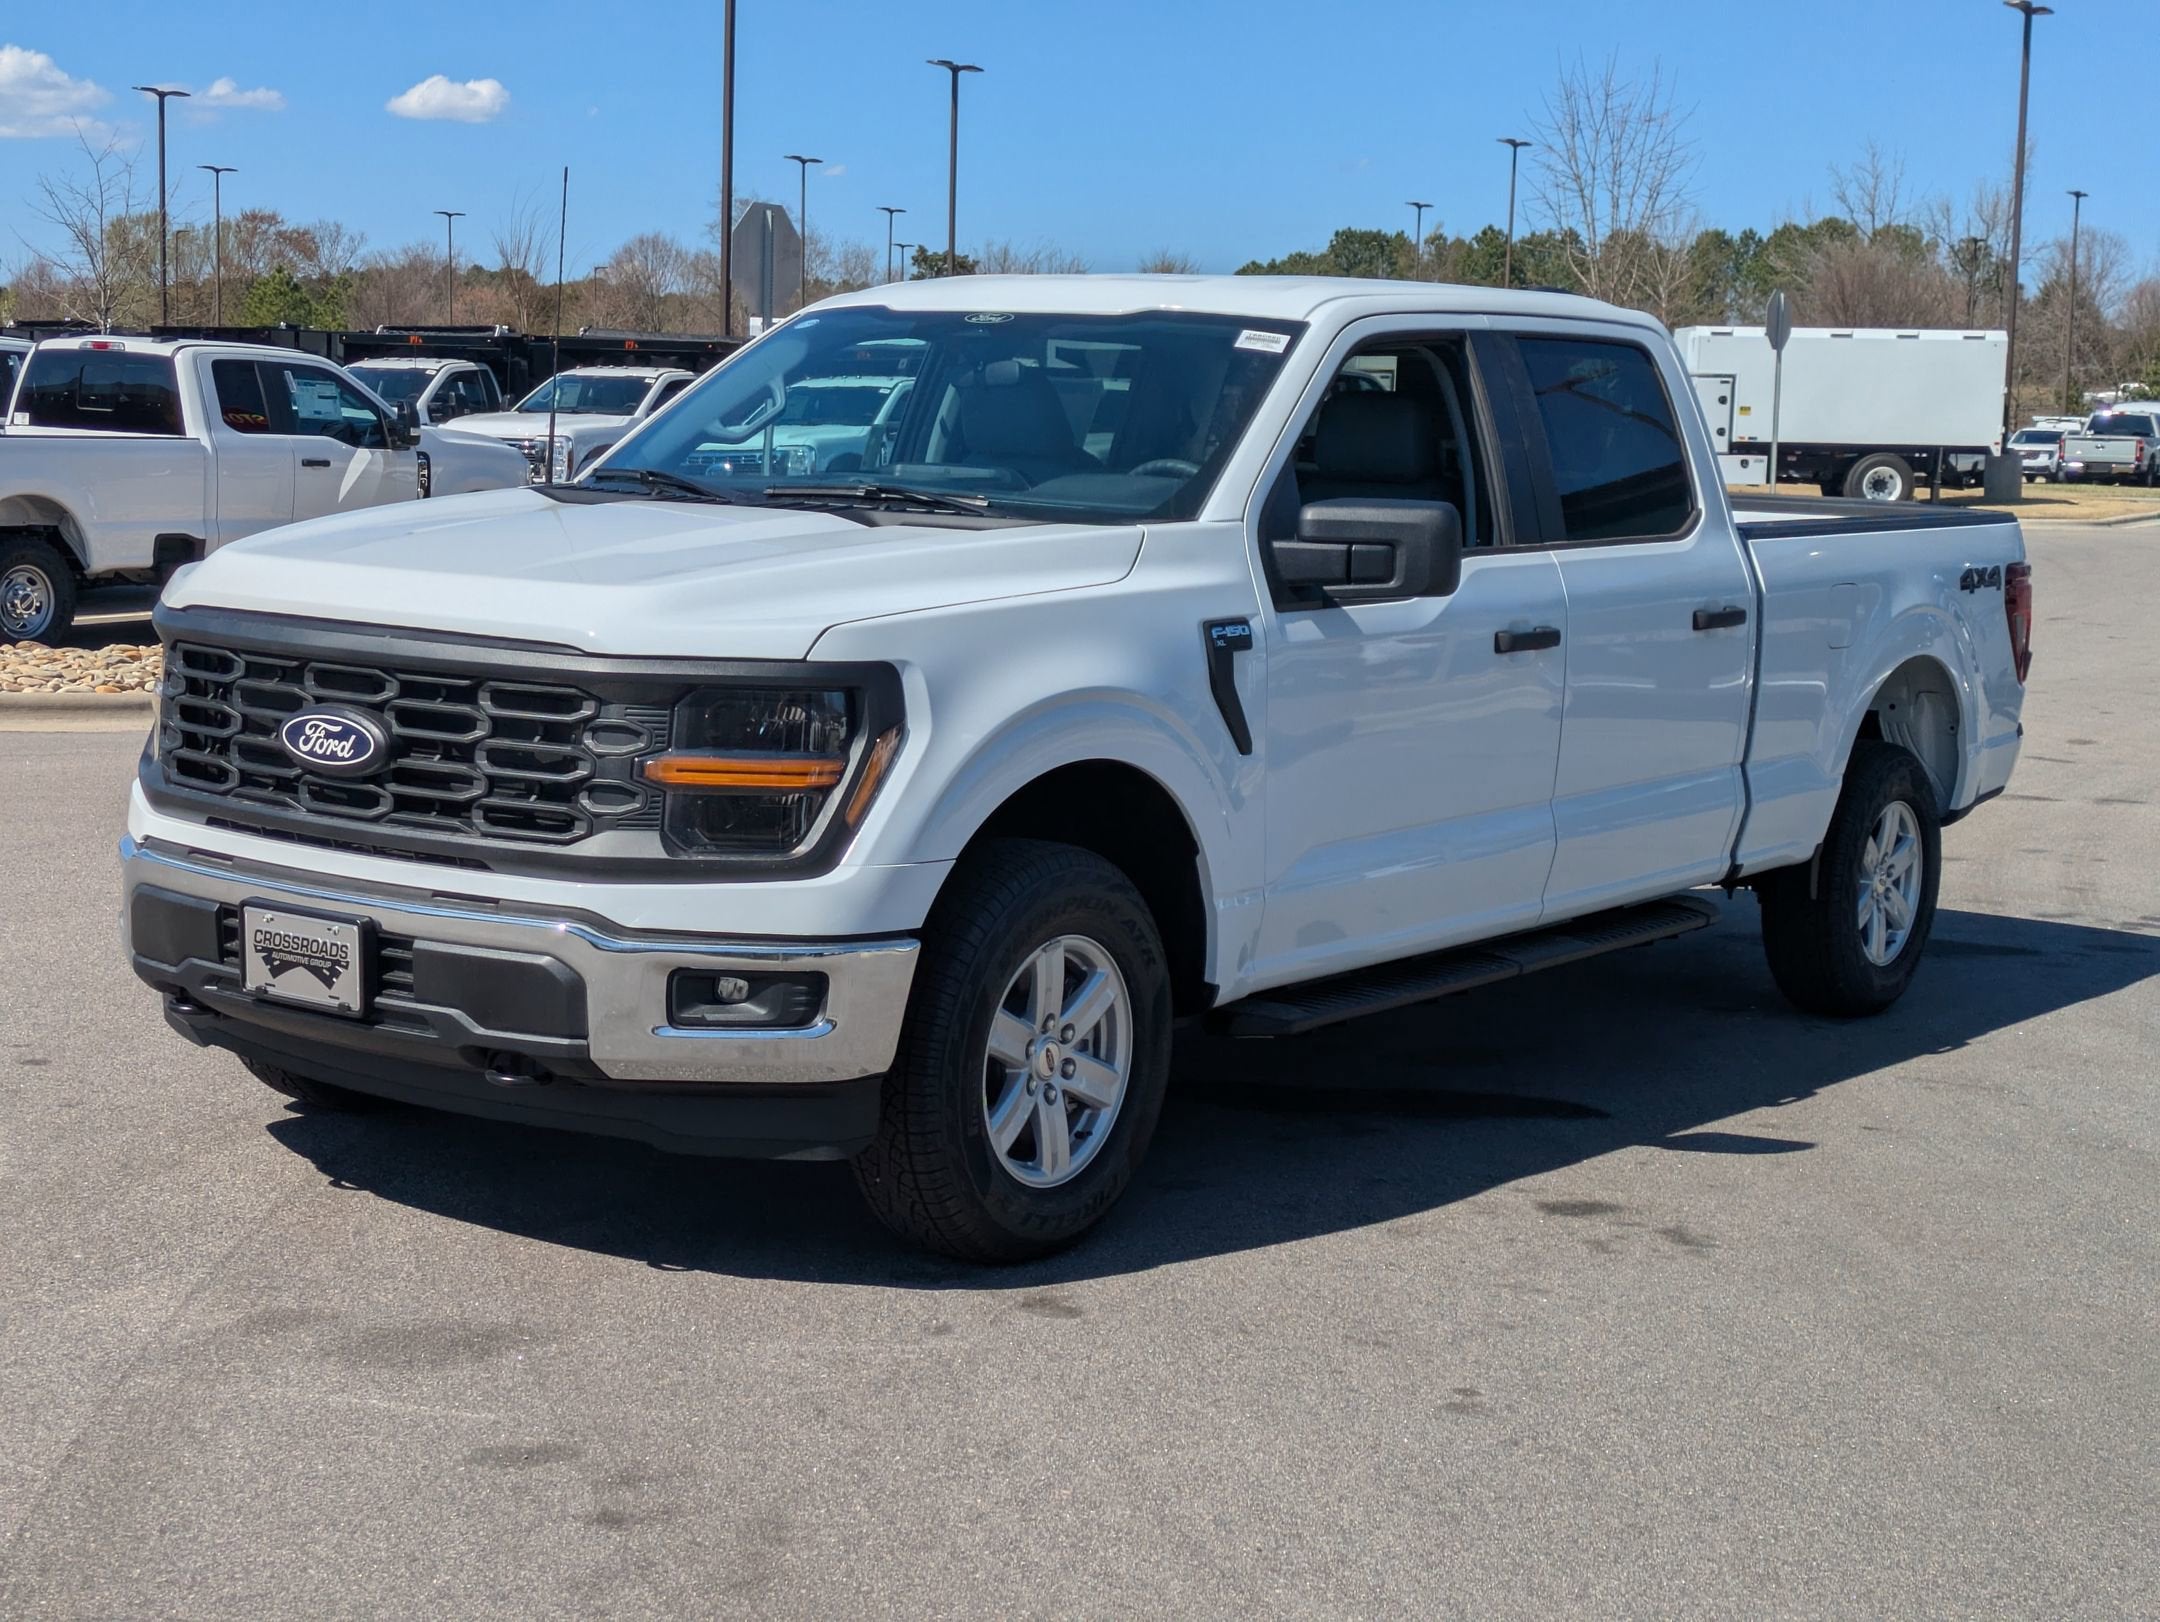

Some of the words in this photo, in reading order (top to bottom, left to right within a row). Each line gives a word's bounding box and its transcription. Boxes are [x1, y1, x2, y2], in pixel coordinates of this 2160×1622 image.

[1216, 639, 1227, 647] XL
[299, 720, 357, 759] Ford
[254, 929, 349, 960] CROSSROADS
[272, 951, 309, 965] AUTOMOTIVE
[309, 958, 332, 968] GROUP
